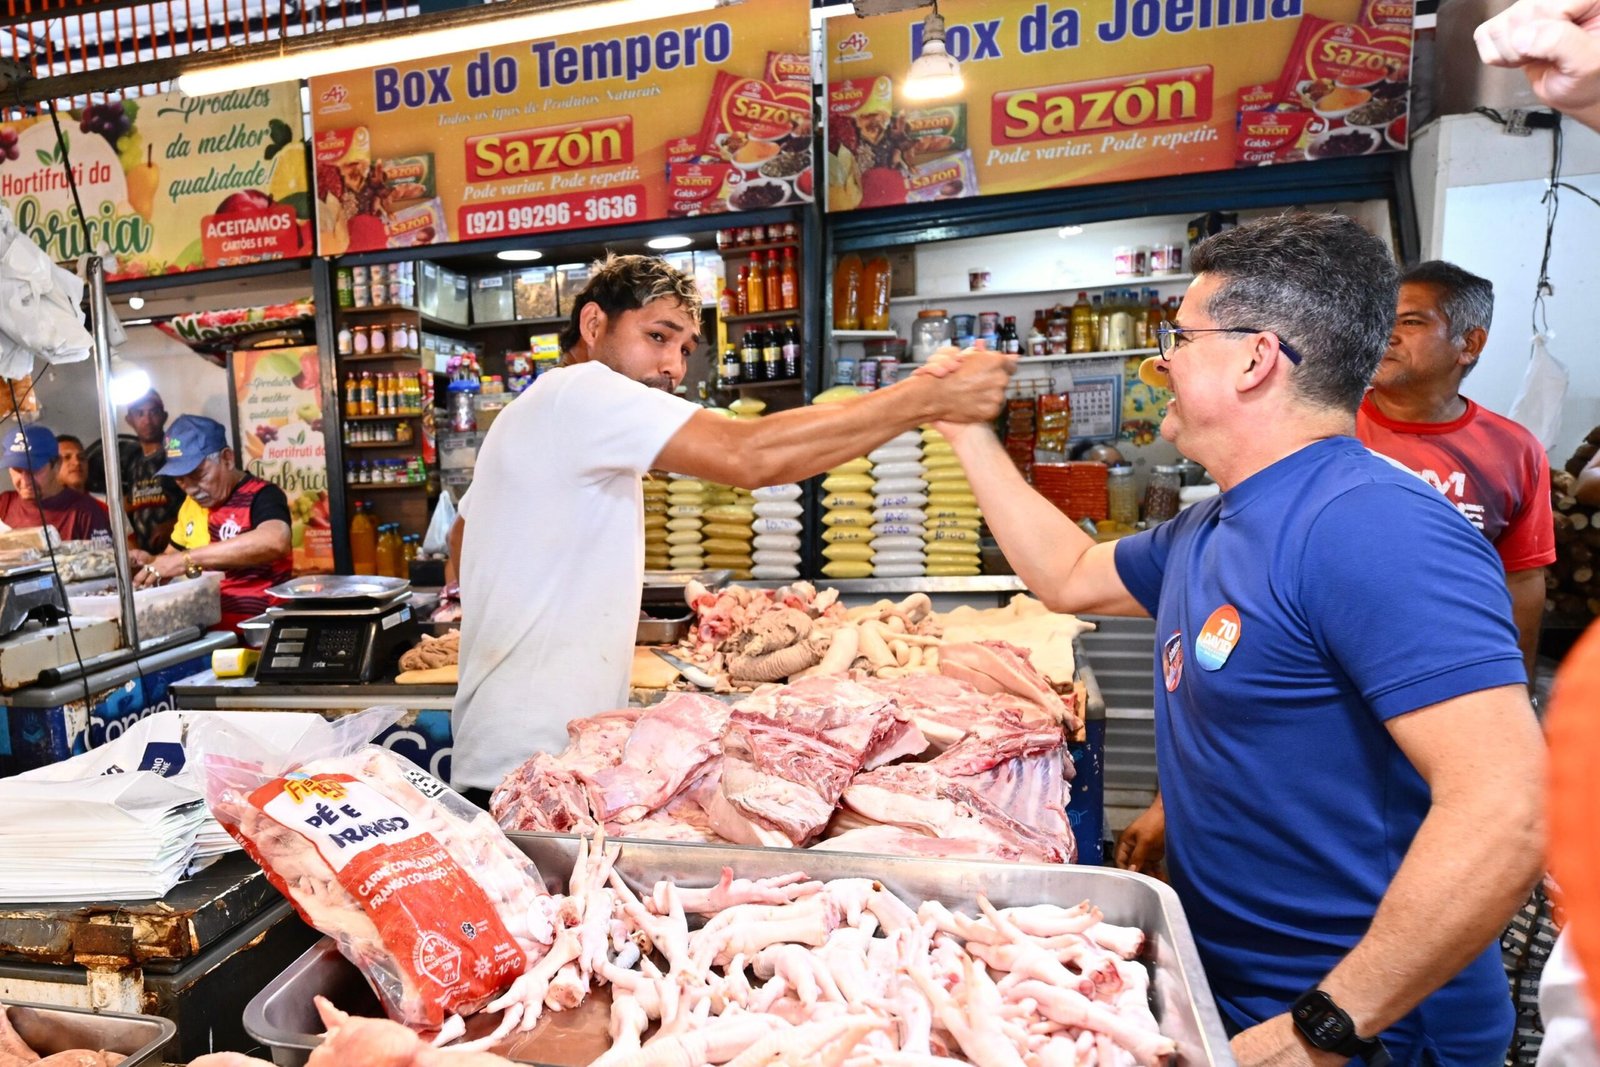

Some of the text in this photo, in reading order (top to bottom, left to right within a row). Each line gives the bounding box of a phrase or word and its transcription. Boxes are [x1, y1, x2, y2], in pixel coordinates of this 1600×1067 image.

[1019, 3, 1079, 54] da
[373, 21, 732, 114] Box do Tempero
[438, 113, 471, 127] Todos
[492, 104, 520, 120] tipos
[524, 100, 539, 113] de
[543, 92, 600, 112] Produtos
[606, 84, 663, 103] Naturais
[1003, 78, 1198, 139] Sazón
[165, 122, 271, 160] da melhor
[475, 127, 623, 178] Sazón
[985, 125, 1219, 167] Pode variar. Pode repetir.
[2, 160, 111, 197] Hortifruti da
[168, 158, 278, 204] qualidade!
[463, 166, 641, 201] Pode variar. Pode repetir.
[19, 199, 149, 260] bricia
[206, 213, 291, 239] ACEITAMOS
[466, 207, 505, 235] (92)
[507, 202, 570, 231] 99296
[584, 193, 638, 222] 3636
[221, 235, 278, 252] CARTÕES E PIX
[268, 446, 313, 459] Hortifruti
[247, 459, 328, 491] Fabrici
[1216, 618, 1238, 642] 70
[304, 802, 362, 829] PÉ E
